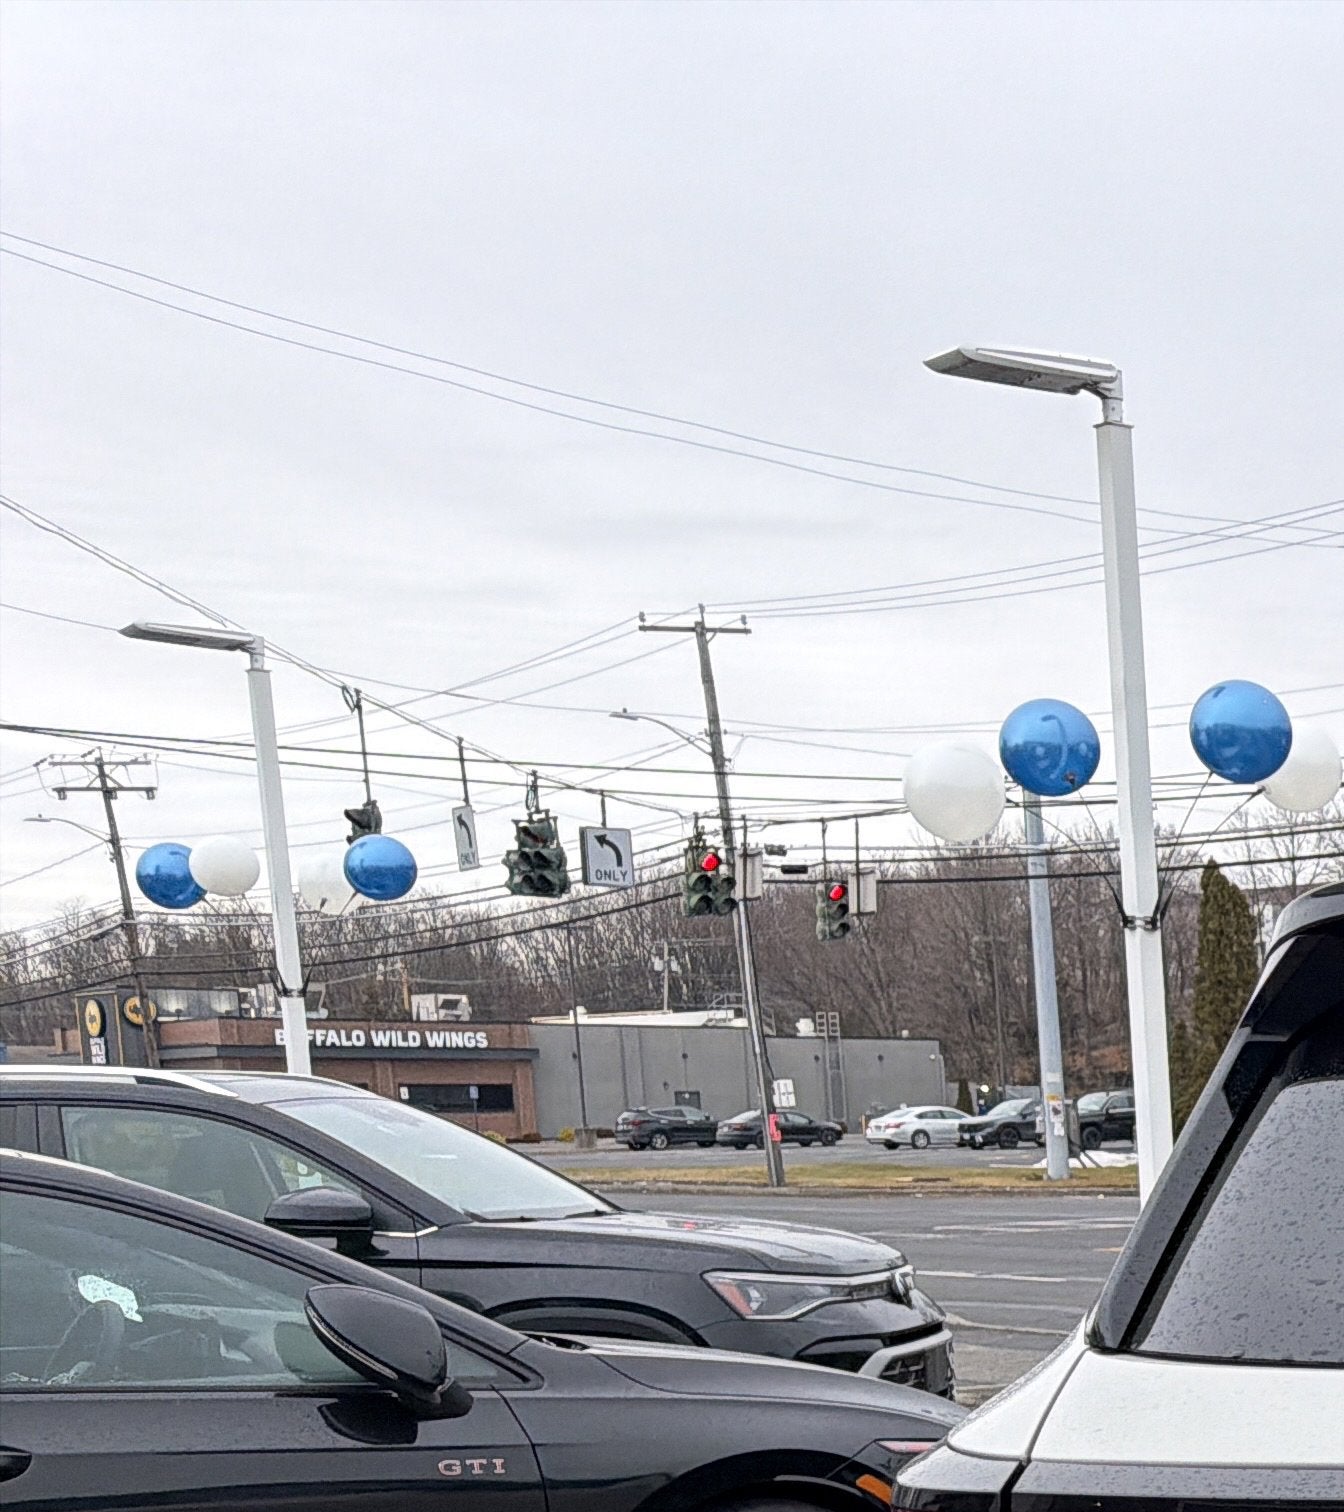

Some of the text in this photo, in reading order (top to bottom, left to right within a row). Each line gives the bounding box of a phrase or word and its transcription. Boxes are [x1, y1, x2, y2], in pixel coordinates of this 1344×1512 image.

[594, 868, 629, 883] ONLY
[274, 1028, 489, 1049] BFFALO WILD WINGS
[437, 1458, 506, 1477] GTI
